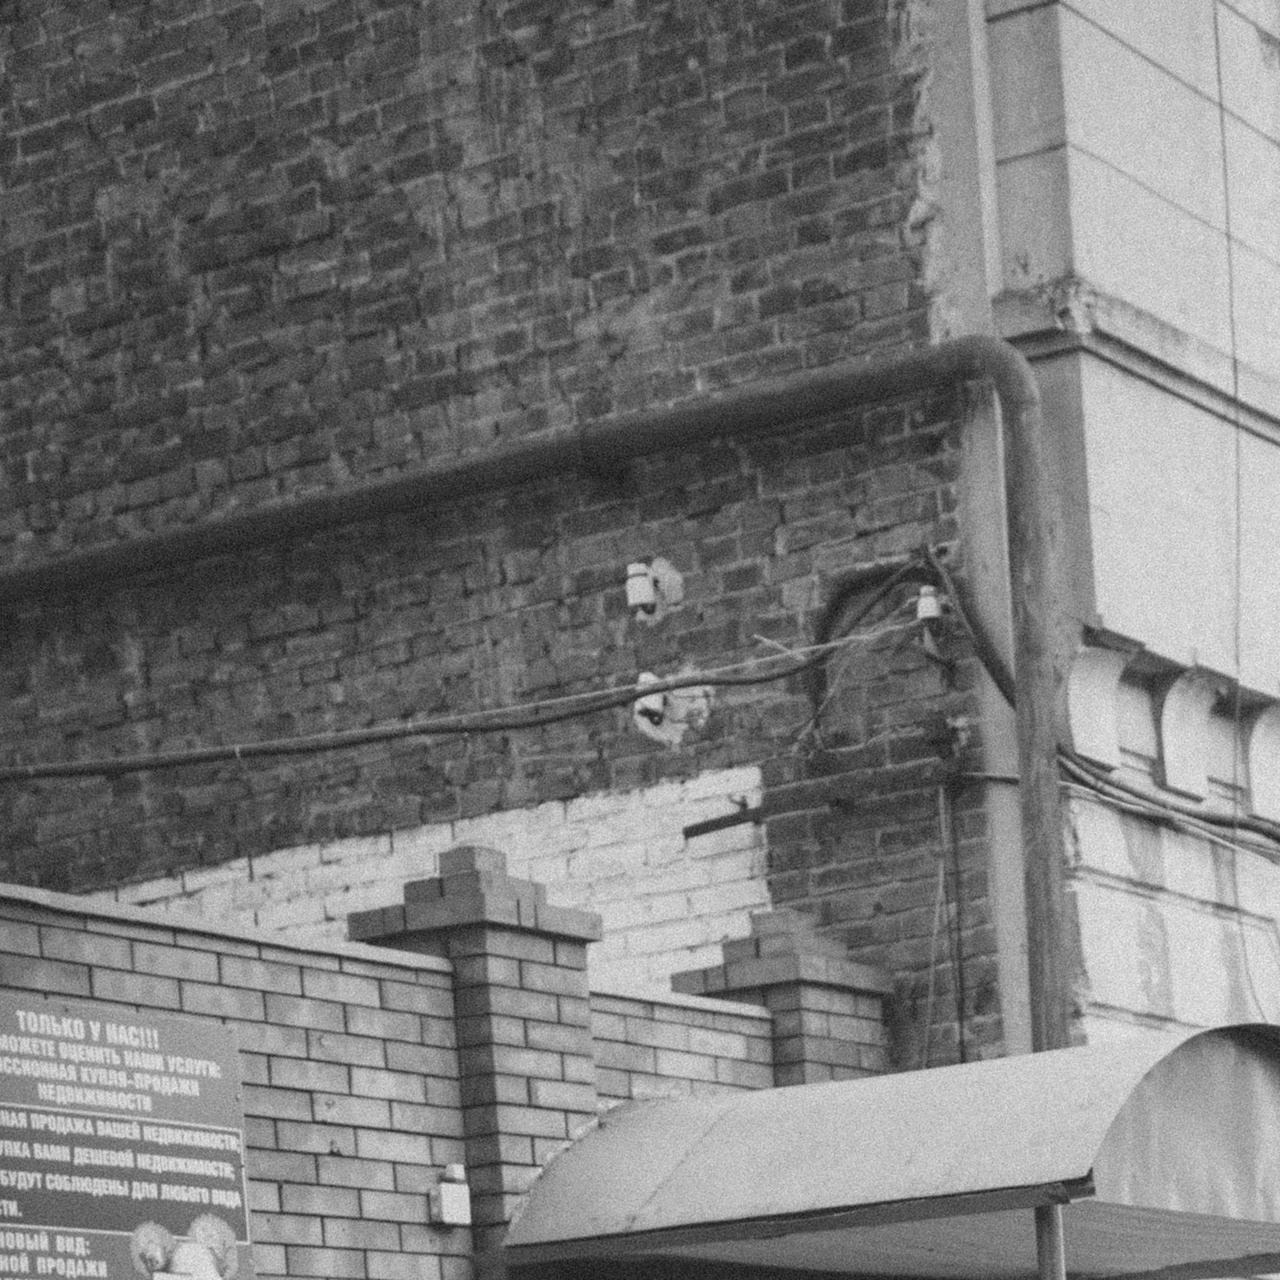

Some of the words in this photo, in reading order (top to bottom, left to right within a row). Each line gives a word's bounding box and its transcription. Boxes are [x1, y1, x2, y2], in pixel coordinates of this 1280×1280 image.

[16, 1009, 85, 1040] ТОЛЬКО
[89, 1020, 100, 1041] У
[106, 1022, 159, 1050] НАС!!!
[59, 1042, 120, 1065] ОЦЕНИТЬ
[124, 1050, 164, 1072] НАШИ
[38, 1082, 151, 1112] НЕДВИЖИМОСТИ
[30, 1113, 94, 1135] ПРОДАЖА
[97, 1119, 140, 1140] ВАШЕЙ
[33, 1143, 71, 1162] ВАМИ
[74, 1146, 134, 1168] ДЕШЕВОЙ
[0, 1169, 42, 1190] БУДУТ
[45, 1172, 129, 1197] СОБЛЮДЕНЫ
[132, 1180, 158, 1200] ДЛЯ
[160, 1183, 210, 1204] ЛЮБОГО
[211, 1189, 242, 1209] ВИДА
[56, 1235, 91, 1256] ВИД:
[37, 1256, 107, 1279] ПРОДАЖИ
